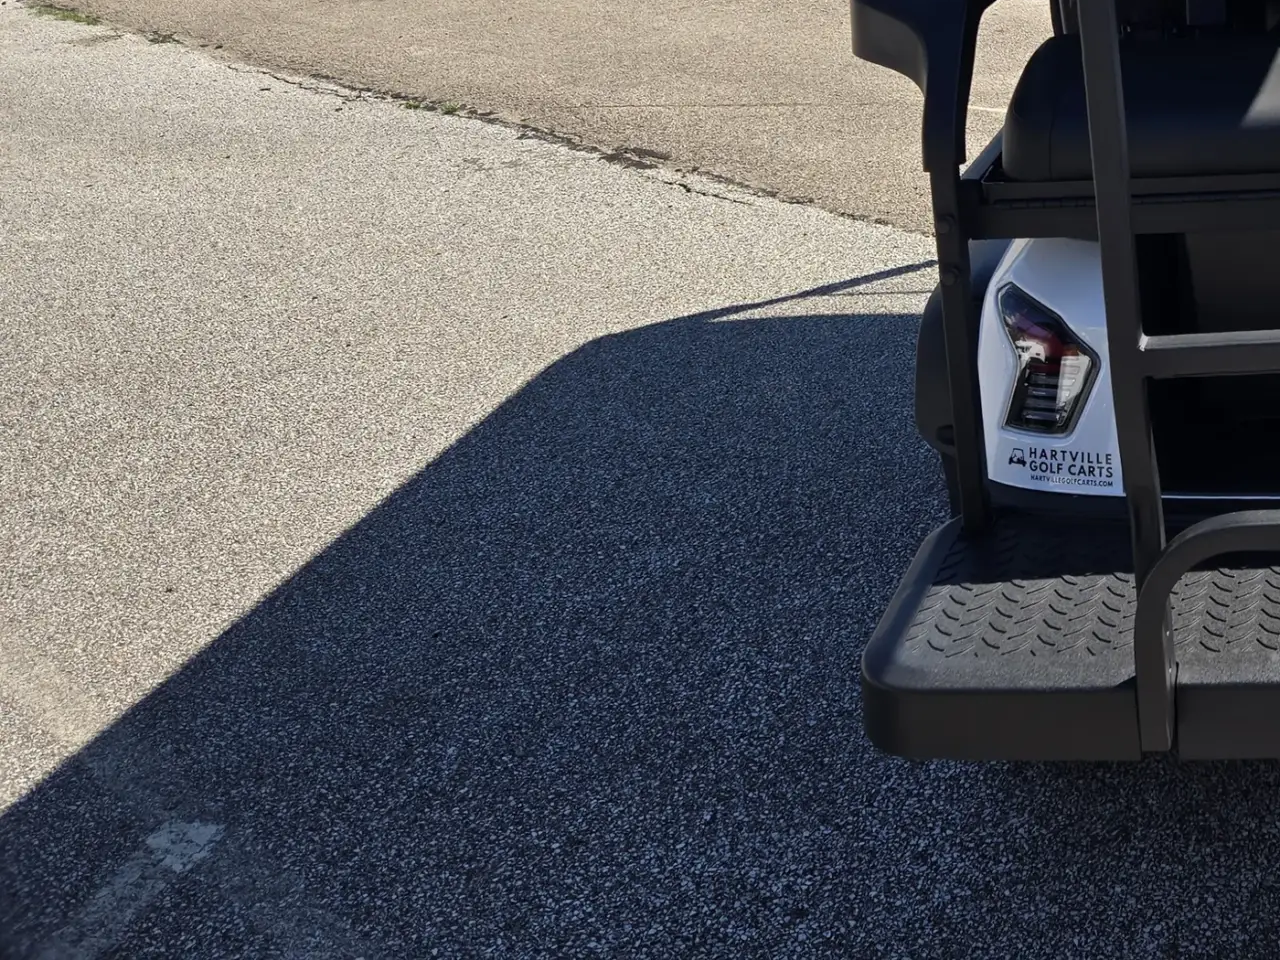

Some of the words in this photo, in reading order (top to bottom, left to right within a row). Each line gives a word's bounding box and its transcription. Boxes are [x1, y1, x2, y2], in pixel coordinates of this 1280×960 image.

[1029, 447, 1112, 465] HARTVILLE
[1029, 461, 1063, 474] GOLF
[1068, 464, 1113, 478] CARTS
[1030, 474, 1114, 487] HARTVILLEGOLFCARTS.COM
